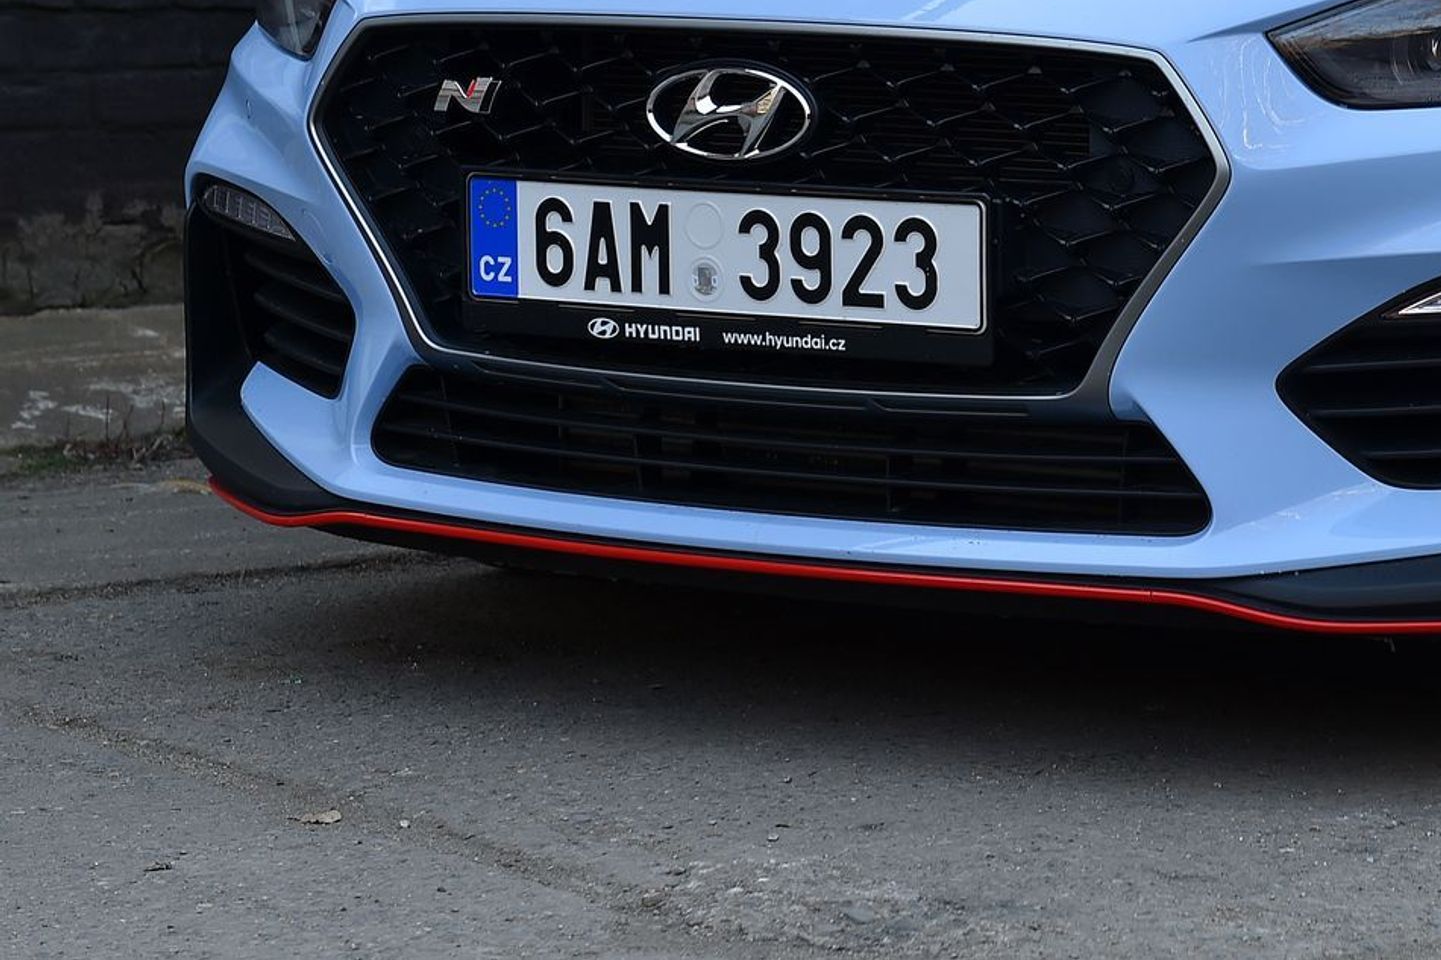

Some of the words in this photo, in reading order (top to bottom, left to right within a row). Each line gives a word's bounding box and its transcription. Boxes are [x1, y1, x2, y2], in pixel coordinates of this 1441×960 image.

[434, 77, 502, 114] N
[480, 255, 512, 283] CZ
[535, 197, 671, 295] 6AM
[738, 209, 938, 310] 3923
[624, 322, 700, 342] HYUNDAI
[723, 331, 846, 351] www.hyundai.cz
